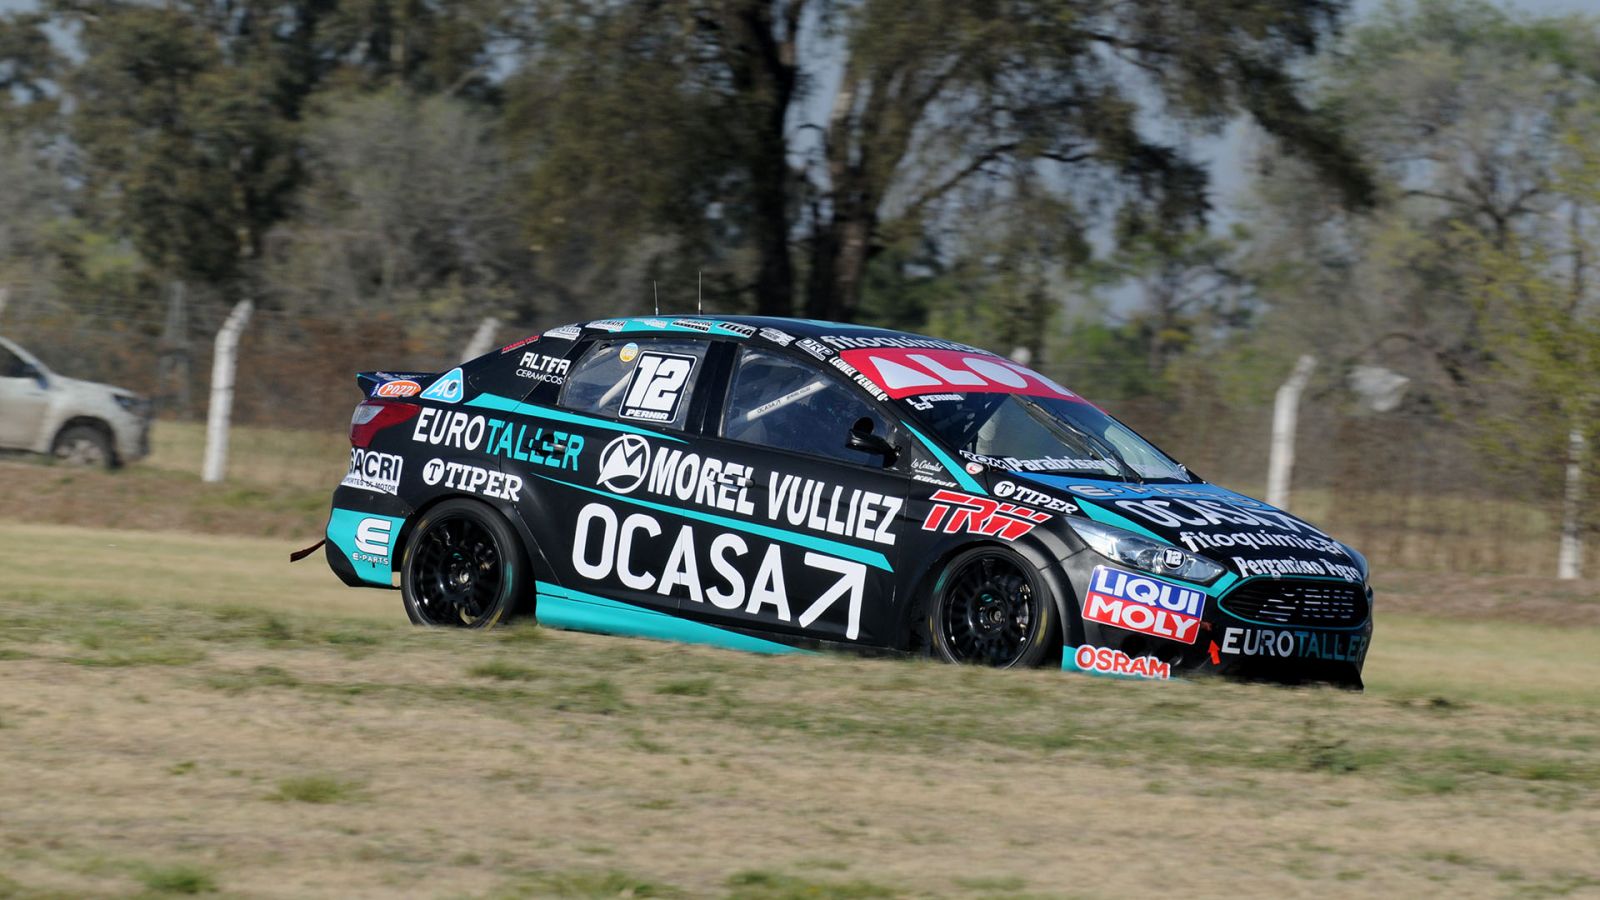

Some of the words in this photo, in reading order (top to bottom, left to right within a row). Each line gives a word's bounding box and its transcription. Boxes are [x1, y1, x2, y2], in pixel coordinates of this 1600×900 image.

[515, 368, 564, 385] CERAMICOS
[625, 355, 691, 412] 12
[828, 356, 857, 377] LEONEL
[382, 384, 417, 396] POZZI
[625, 408, 669, 420] PERNIA
[445, 462, 523, 501] TIPER
[647, 446, 755, 516] MOREL
[768, 471, 903, 545] VULLIEZ
[922, 489, 1052, 541] TRW
[1012, 485, 1079, 514] TIPER
[572, 502, 791, 622] OCASA
[1166, 550, 1182, 565] 12
[1231, 555, 1326, 580] Pergamino
[1095, 568, 1200, 615] LIQUI
[1088, 595, 1198, 639] MOLY
[1221, 626, 1369, 662] EUROTALLER
[1076, 646, 1169, 679] OSRAM
